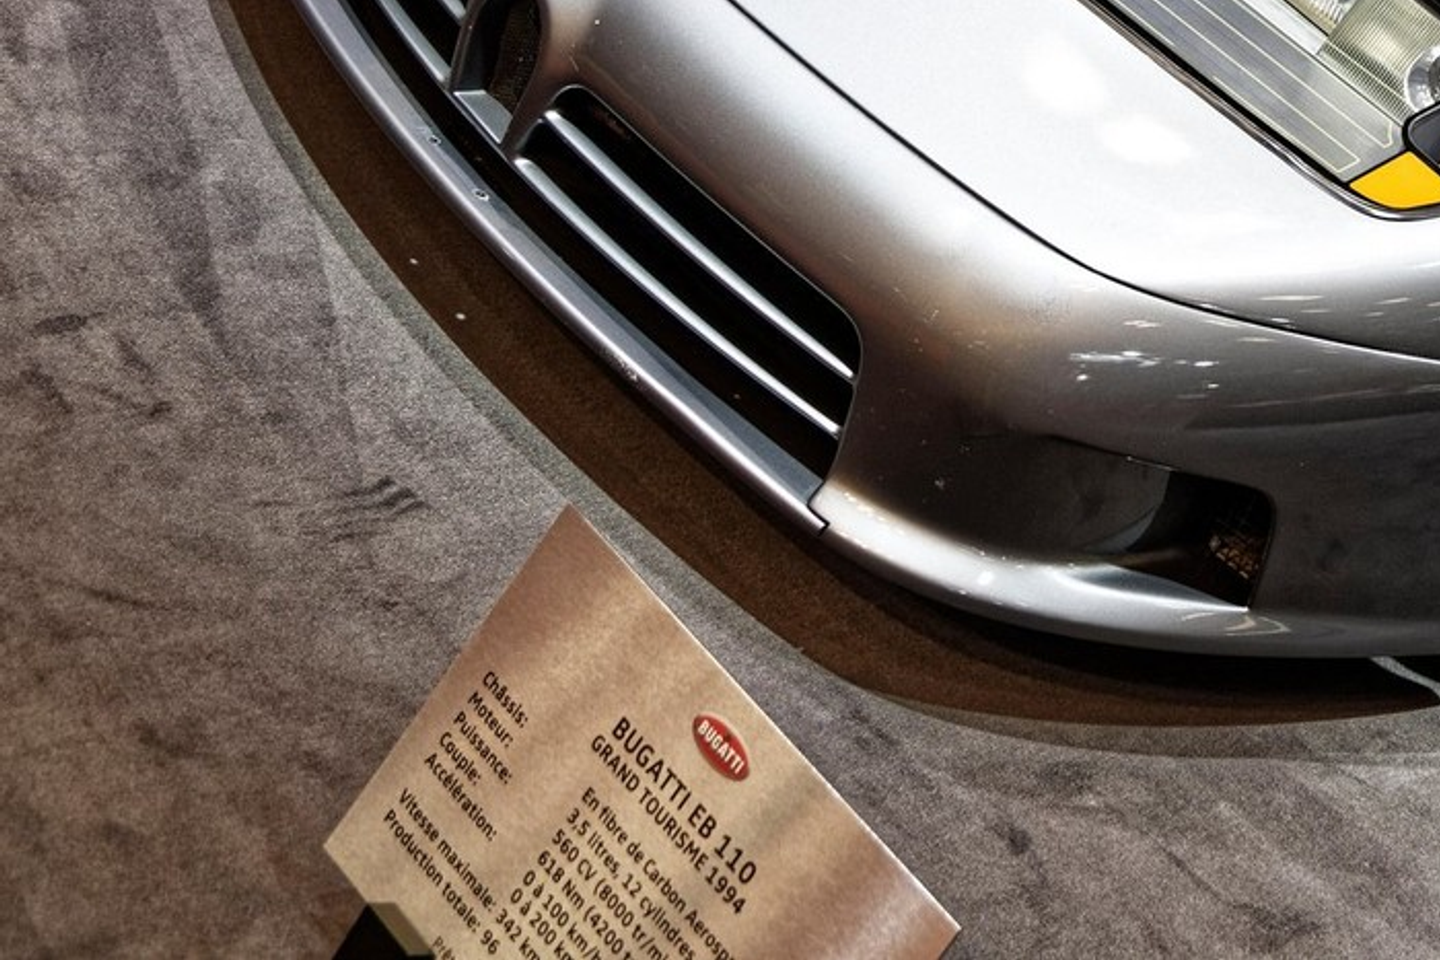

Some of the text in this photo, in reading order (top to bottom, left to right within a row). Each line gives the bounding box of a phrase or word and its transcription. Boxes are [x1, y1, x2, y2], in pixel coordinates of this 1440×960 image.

[466, 691, 514, 749] Moteur:
[481, 670, 529, 729] Châssis:
[439, 731, 482, 787] Couple:
[452, 710, 513, 785] Puissance:
[697, 719, 745, 775] BUGATTI
[423, 752, 497, 842] Accélération:
[590, 733, 747, 915] GRAND TOURISME 1994
[611, 715, 757, 885] BUGATTI EB 110
[382, 808, 501, 955] Production totale: 96
[399, 787, 440, 842] Vitesse
[436, 839, 497, 912] maximale:
[495, 907, 522, 943] 342
[522, 869, 537, 887] 0
[541, 893, 570, 928] 100
[551, 827, 580, 863] 560
[576, 858, 598, 882] CV
[592, 877, 635, 928] (8000
[565, 807, 592, 837] 3,5
[586, 830, 621, 880] litres,
[621, 872, 644, 899] 12
[581, 786, 735, 960] En fibre de Carbon Aerosp
[509, 887, 524, 905] 0
[528, 909, 558, 946] 200
[536, 849, 625, 956] 618 Nm (4200
